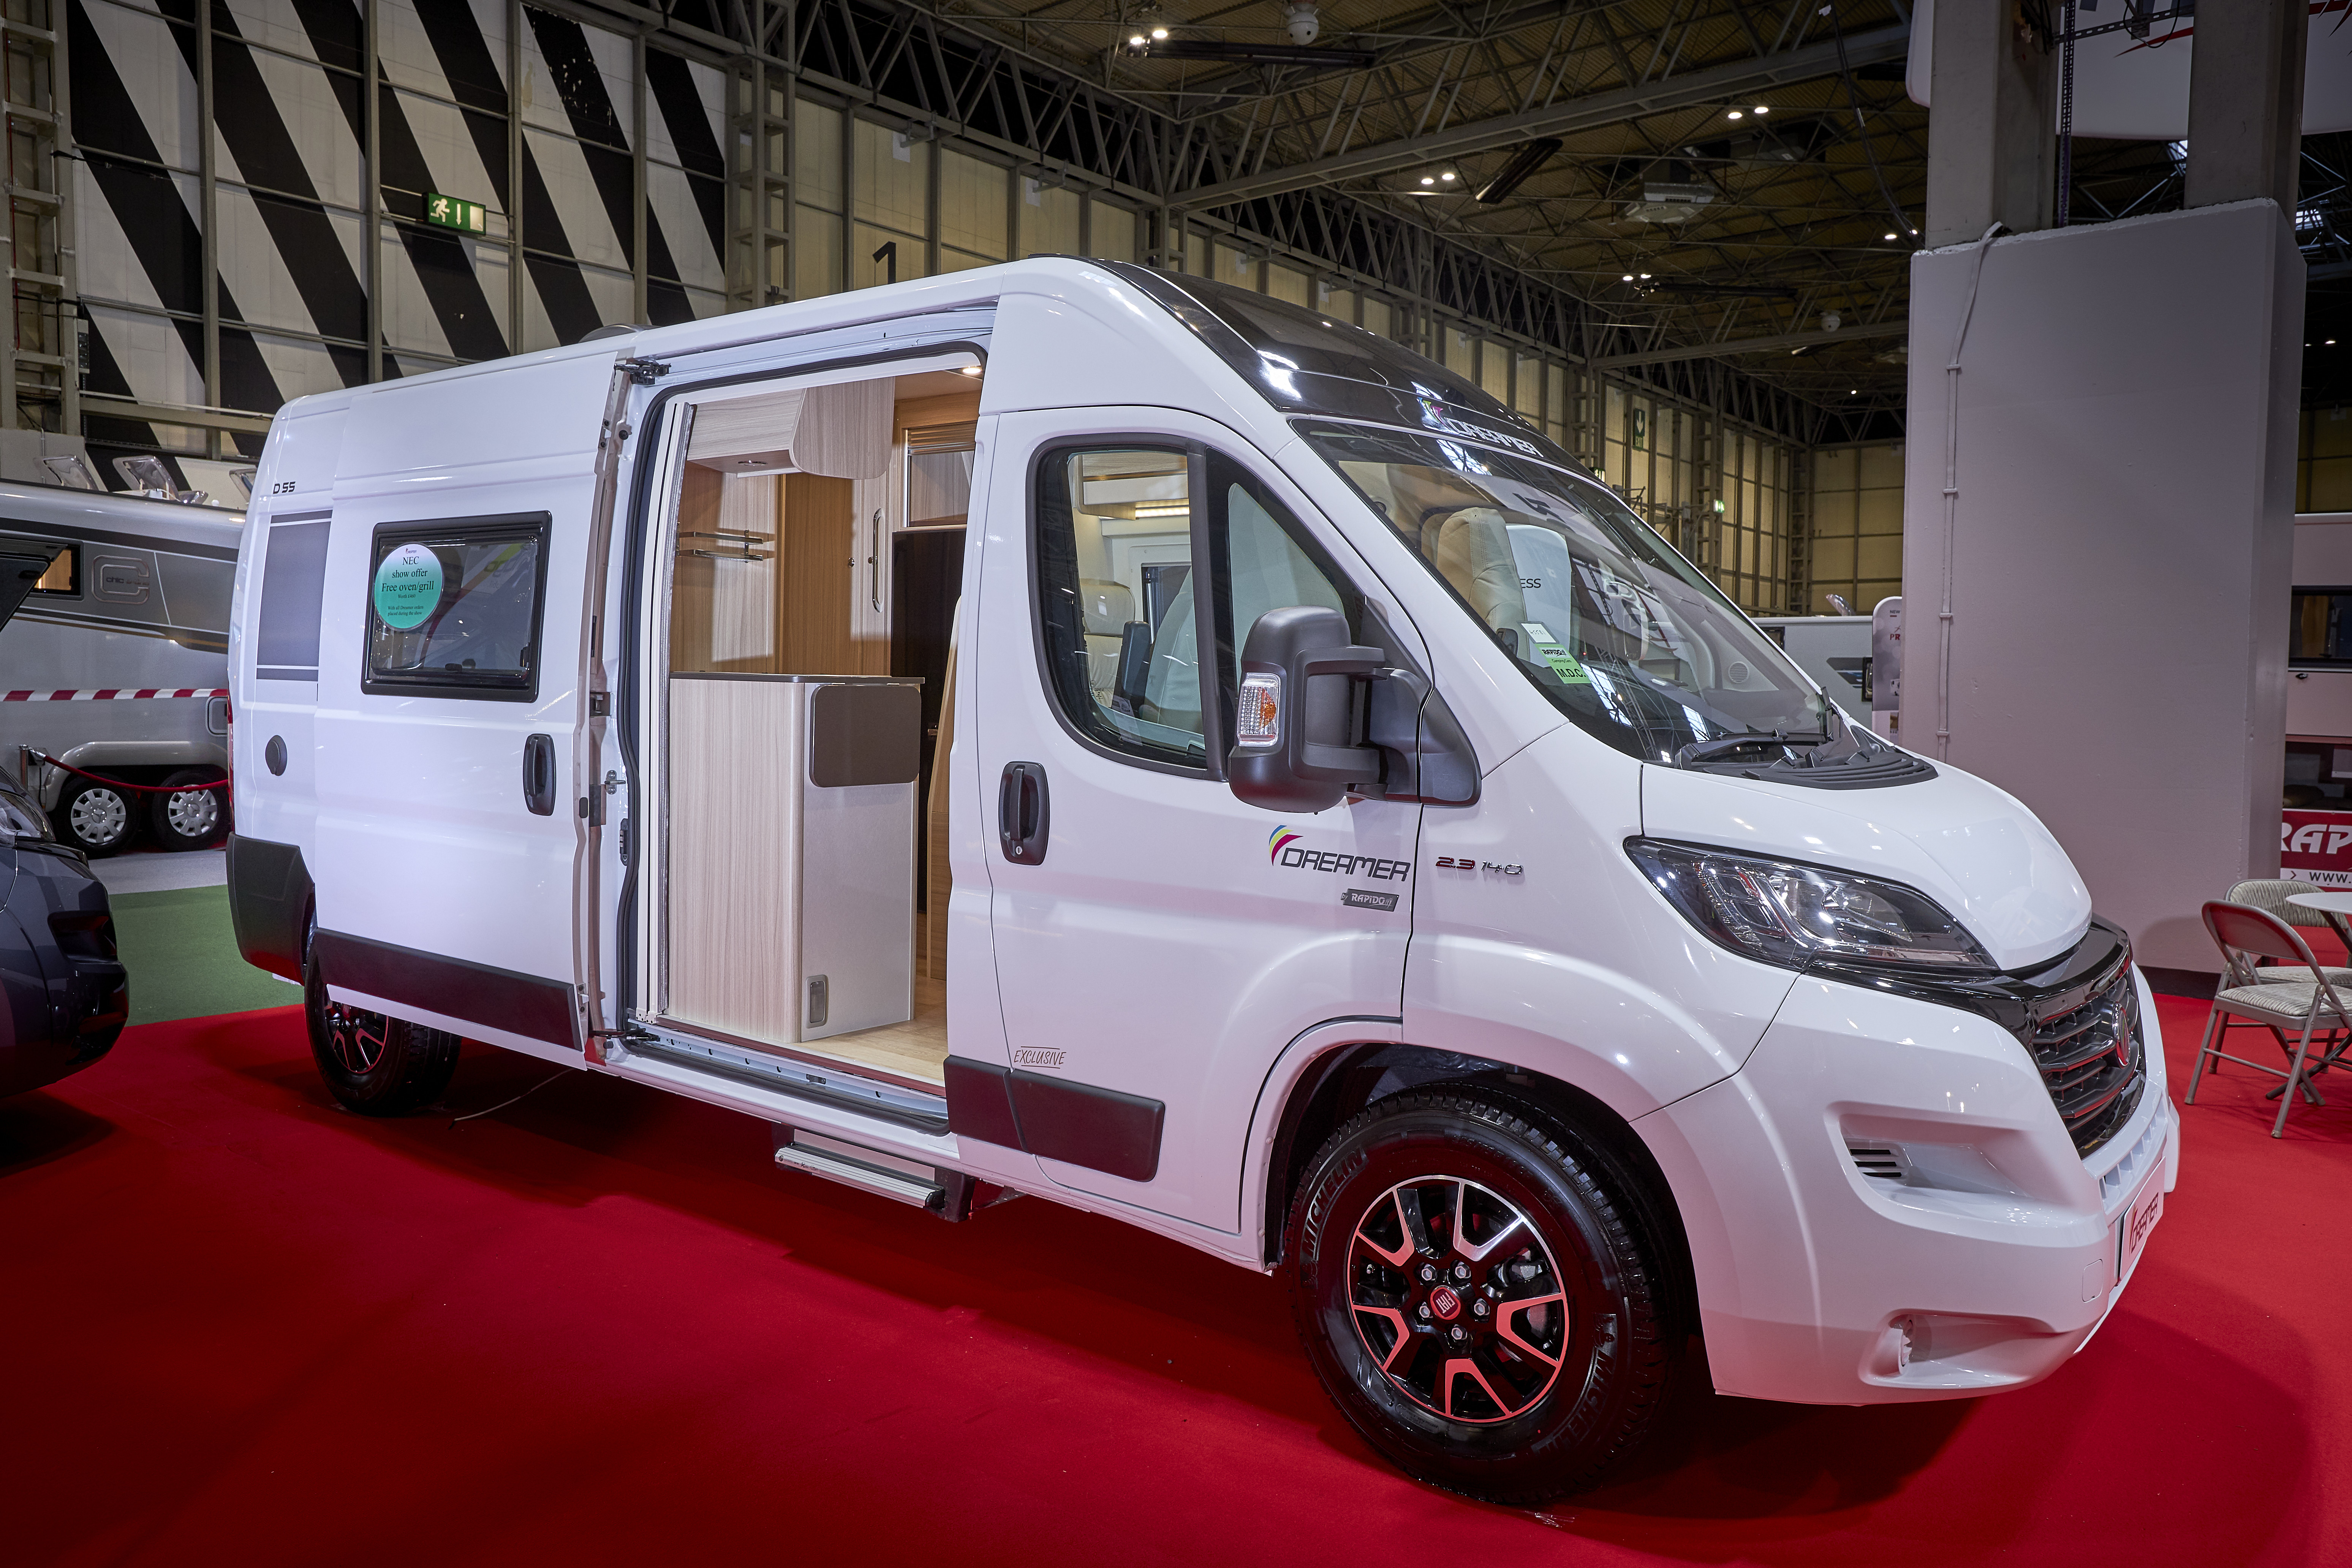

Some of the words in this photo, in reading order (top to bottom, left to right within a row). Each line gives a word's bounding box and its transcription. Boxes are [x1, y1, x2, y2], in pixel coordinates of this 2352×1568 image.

[872, 241, 896, 285] 1
[1443, 417, 1544, 458] DREAMER
[273, 483, 280, 494] D
[402, 556, 419, 565] NEC
[392, 570, 409, 578] show
[411, 568, 428, 577] offer
[381, 583, 397, 592] Free
[399, 581, 434, 593] oven/grill
[1556, 668, 1586, 678] M.D.C.
[1281, 847, 1411, 882] DREAMER
[1435, 856, 1476, 870] 2.3
[1481, 860, 1524, 876] 140
[1014, 1050, 1067, 1065] EXCLUSIVE
[1302, 1146, 1365, 1257] MICHELIN
[2131, 1192, 2159, 1253] DREAMER
[1435, 1291, 1456, 1314] FIAT
